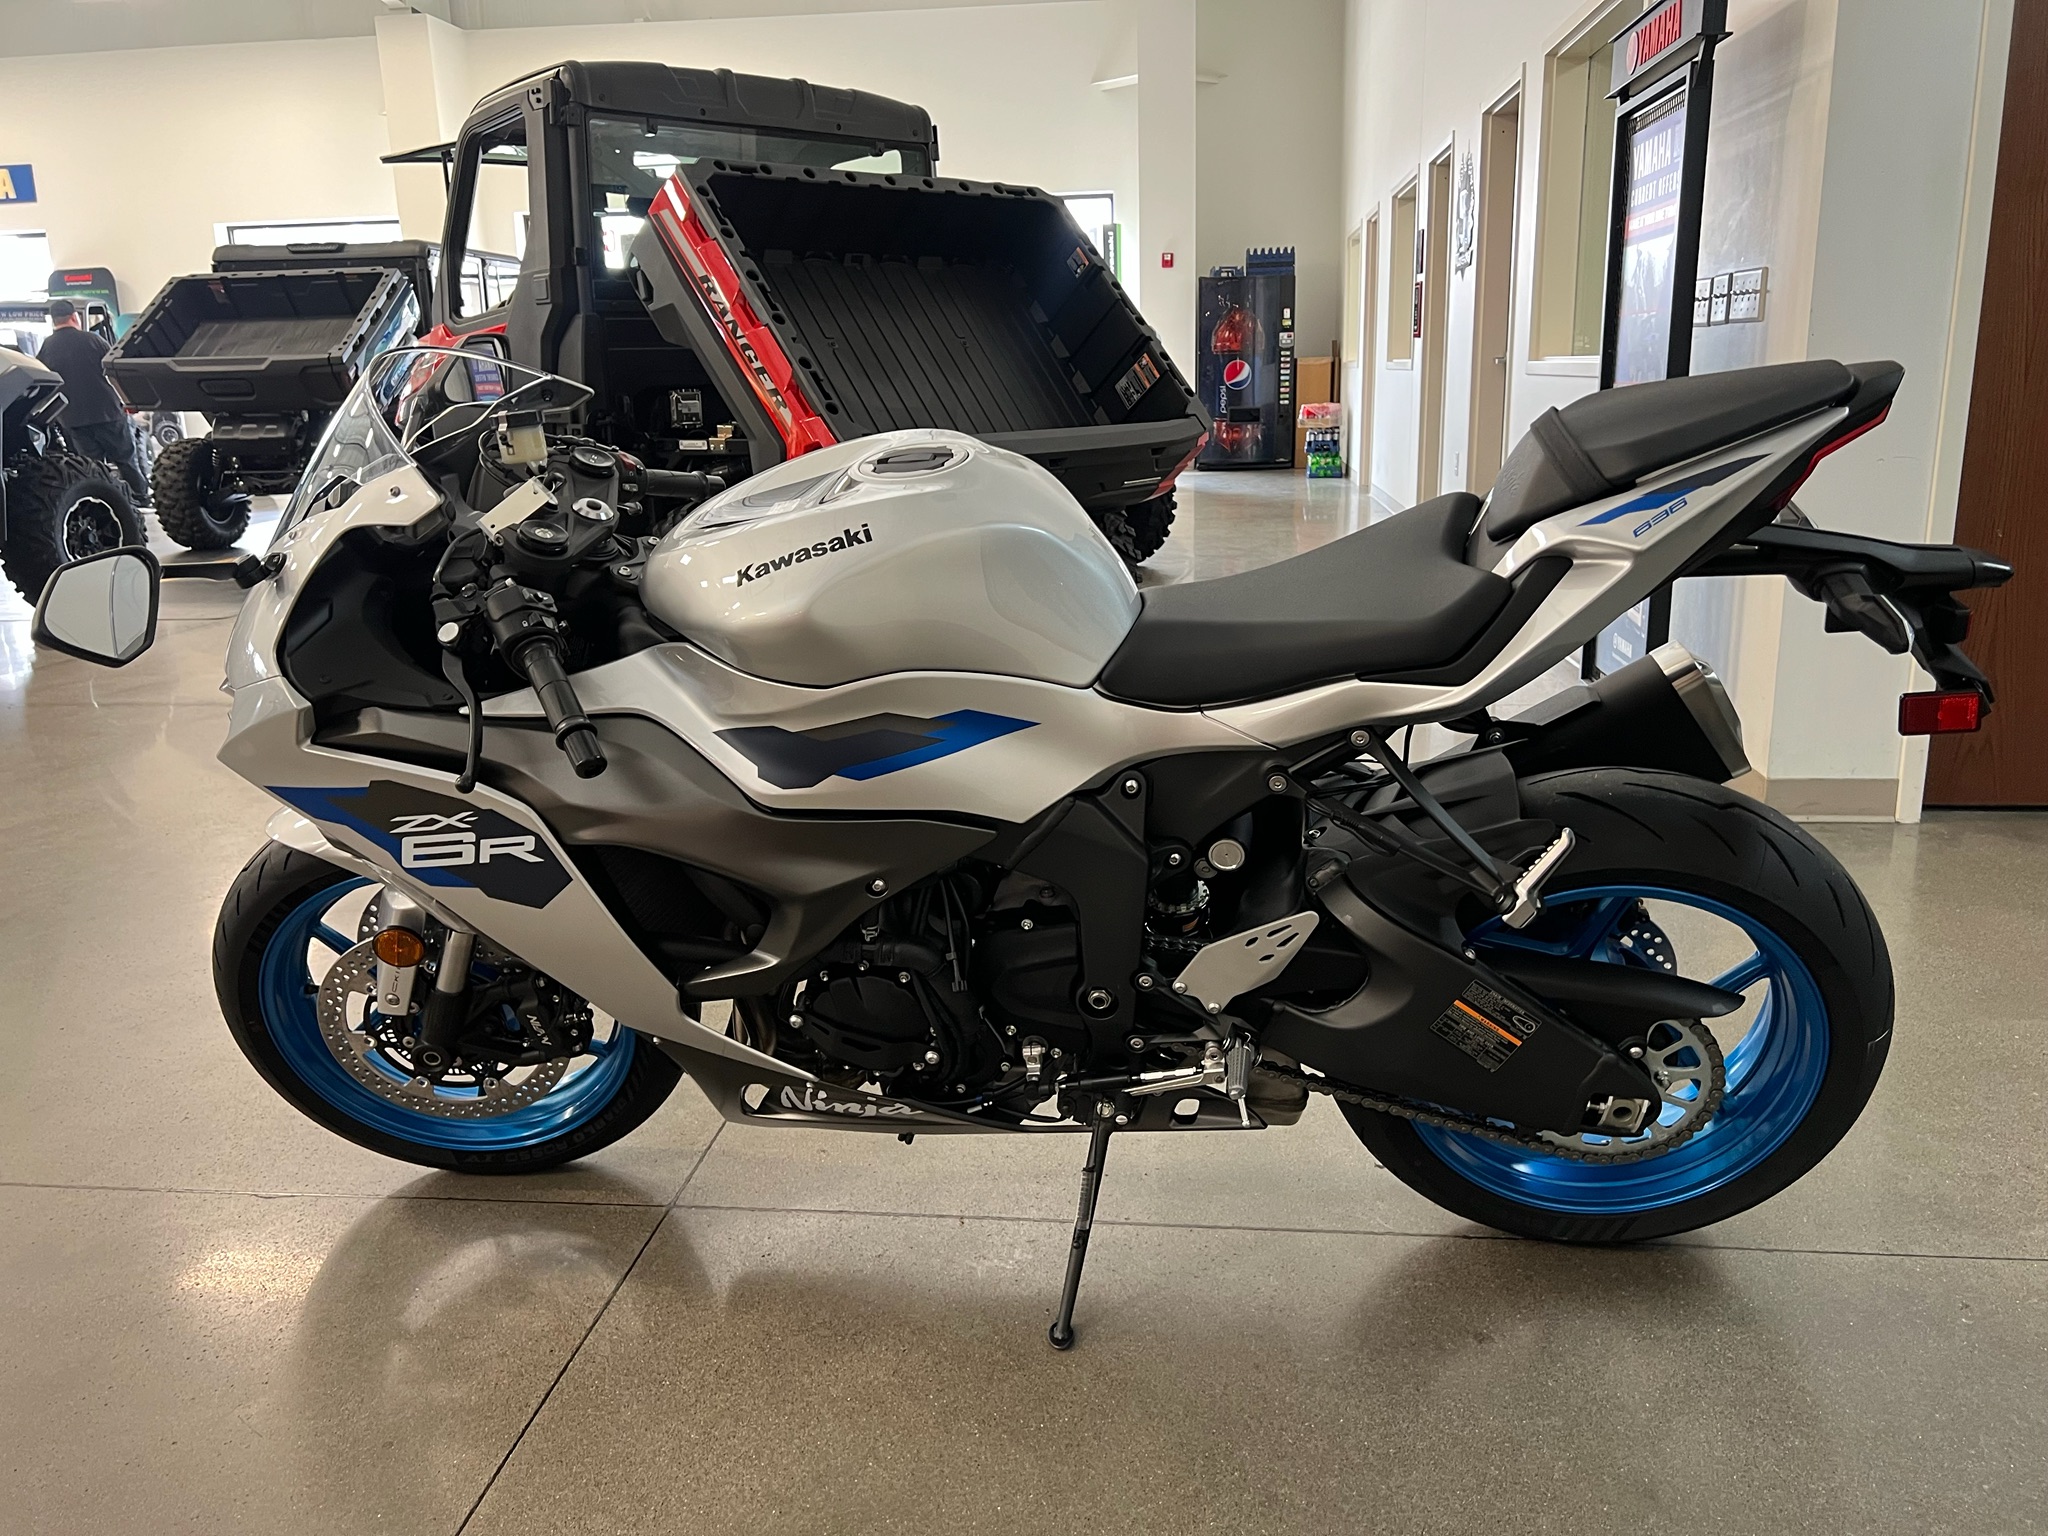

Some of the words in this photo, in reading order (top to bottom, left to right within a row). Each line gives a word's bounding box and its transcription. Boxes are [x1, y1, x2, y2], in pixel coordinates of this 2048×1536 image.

[1638, 0, 1682, 66] YAMAHA
[1633, 128, 1671, 181] YAMAHA
[698, 274, 788, 410] RANGER
[1219, 385, 1228, 413] pepsi
[1632, 497, 1688, 538] 636
[736, 522, 873, 588] Kawasaki
[401, 831, 545, 869] 6R
[780, 1085, 925, 1118] Ninja
